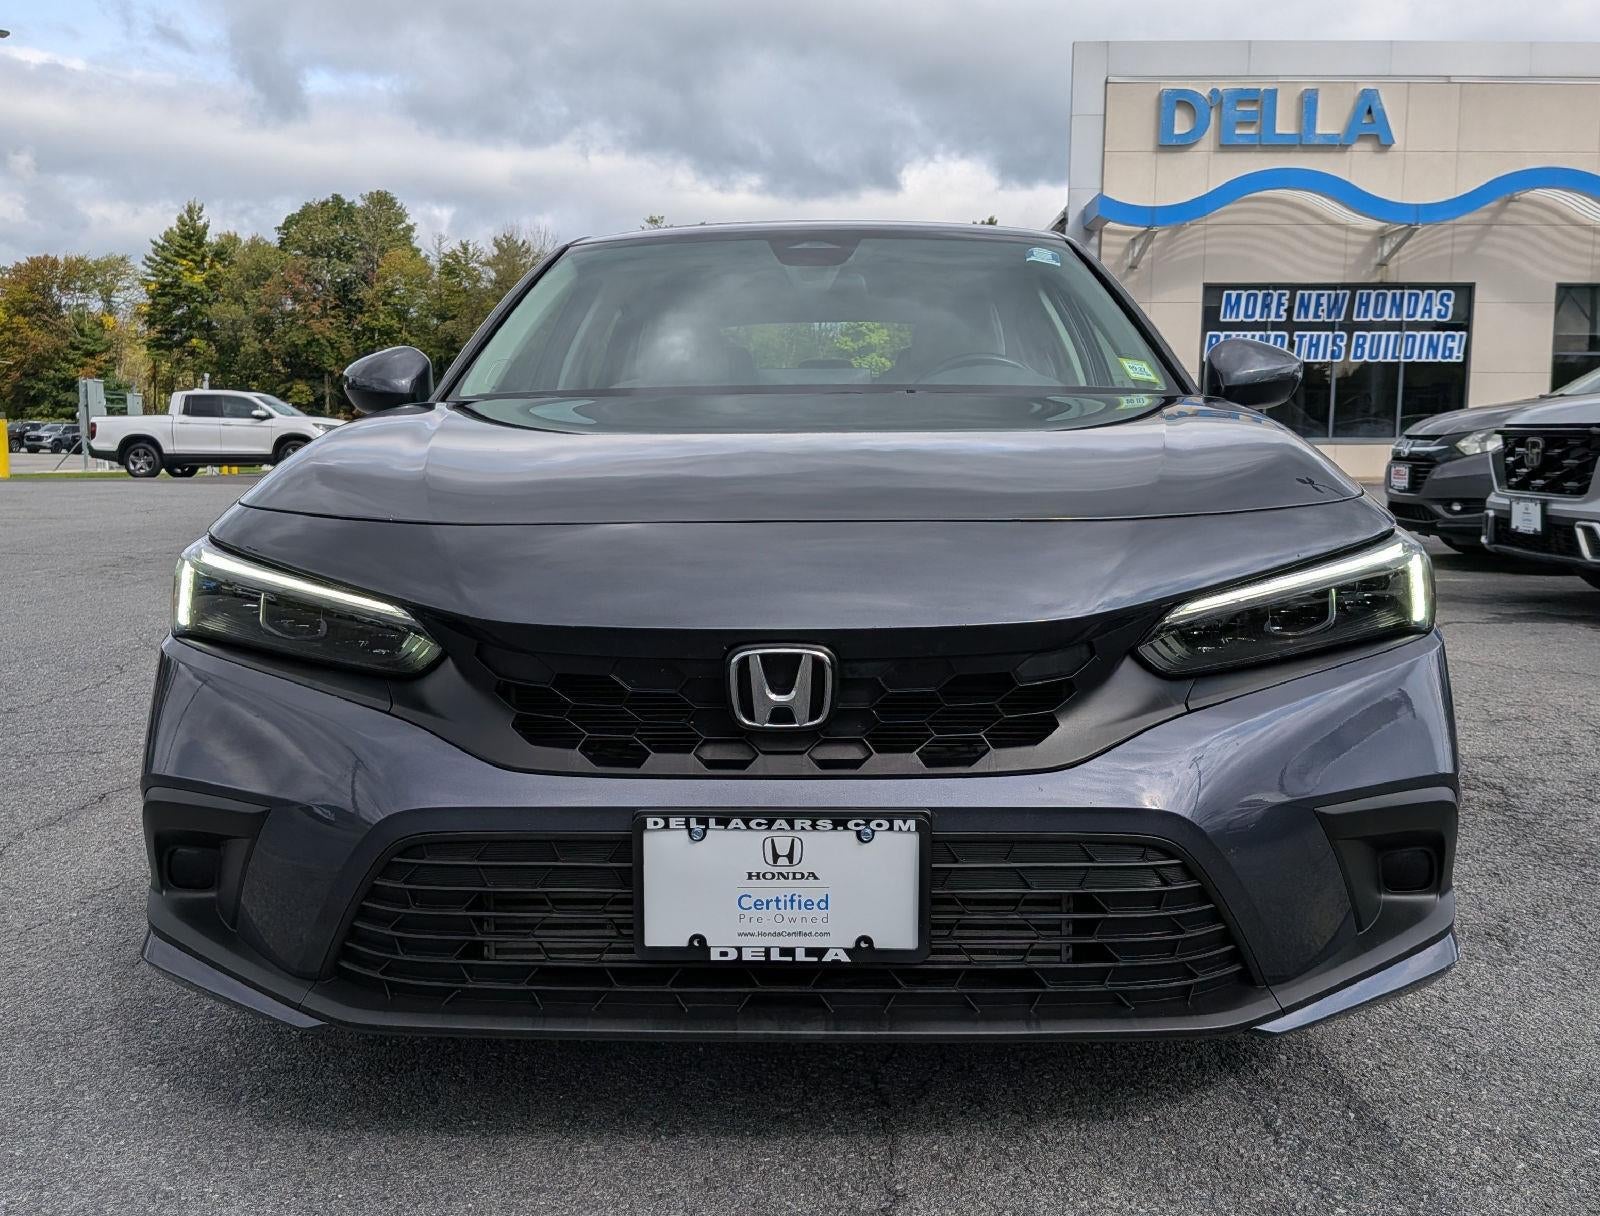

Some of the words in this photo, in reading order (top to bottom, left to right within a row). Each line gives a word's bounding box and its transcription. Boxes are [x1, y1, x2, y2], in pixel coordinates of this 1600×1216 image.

[1159, 88, 1395, 146] D'ELLA
[1220, 290, 1290, 322] MORE
[1292, 290, 1350, 322] NEW
[1353, 290, 1455, 322] HONDAS
[1293, 331, 1347, 362] THIS
[1349, 331, 1467, 362] BUILDING!
[646, 817, 916, 832] DELLACARS.COM
[746, 871, 820, 881] HONDA
[737, 893, 830, 911] Certified
[739, 913, 829, 924] Pre-Owned
[737, 930, 831, 938] www.HondaCertified.com
[710, 946, 851, 962] DELLA
